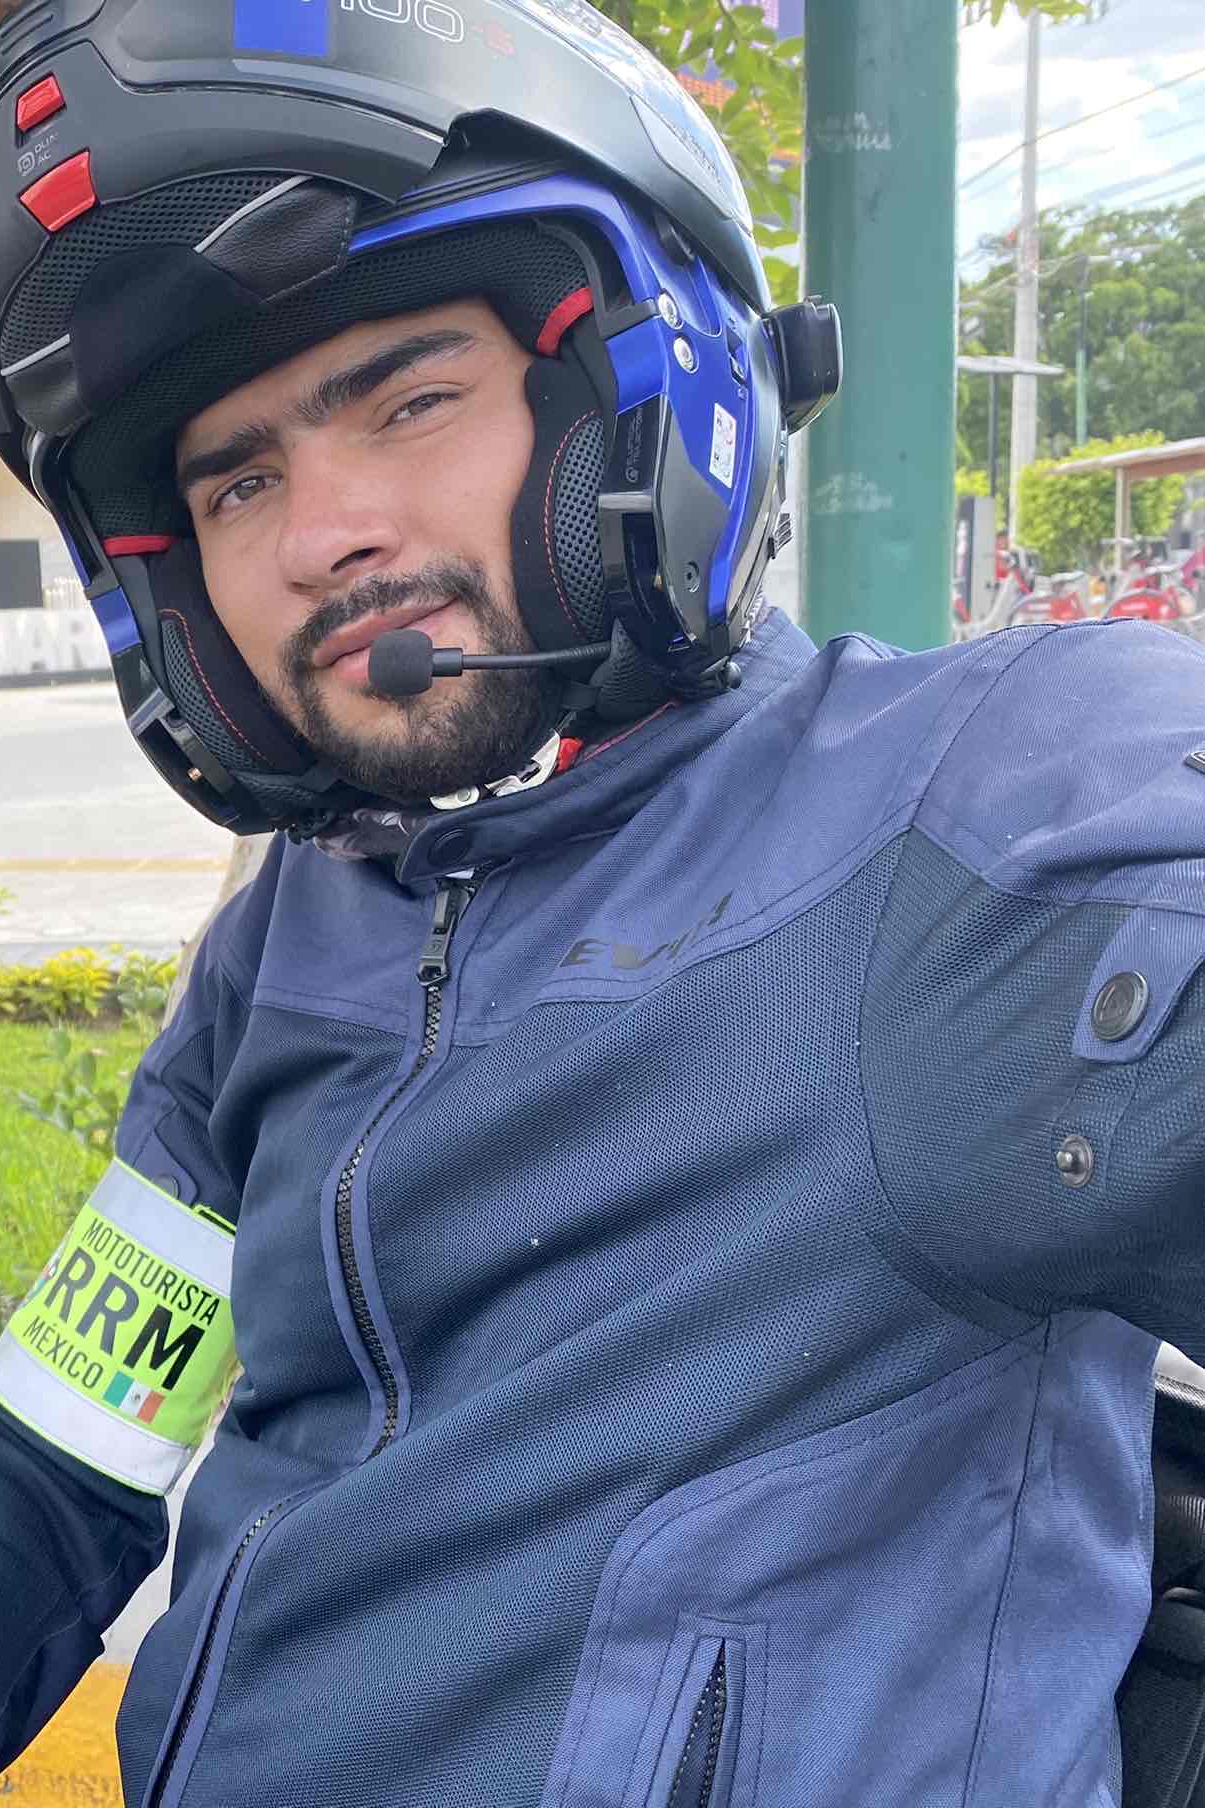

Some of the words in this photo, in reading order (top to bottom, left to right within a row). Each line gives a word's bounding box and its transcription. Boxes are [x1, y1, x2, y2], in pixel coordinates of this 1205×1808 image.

[43, 1246, 206, 1391] RRM
[81, 1217, 221, 1327] MOTOTURISTA
[22, 1315, 104, 1390] MÉXICO
